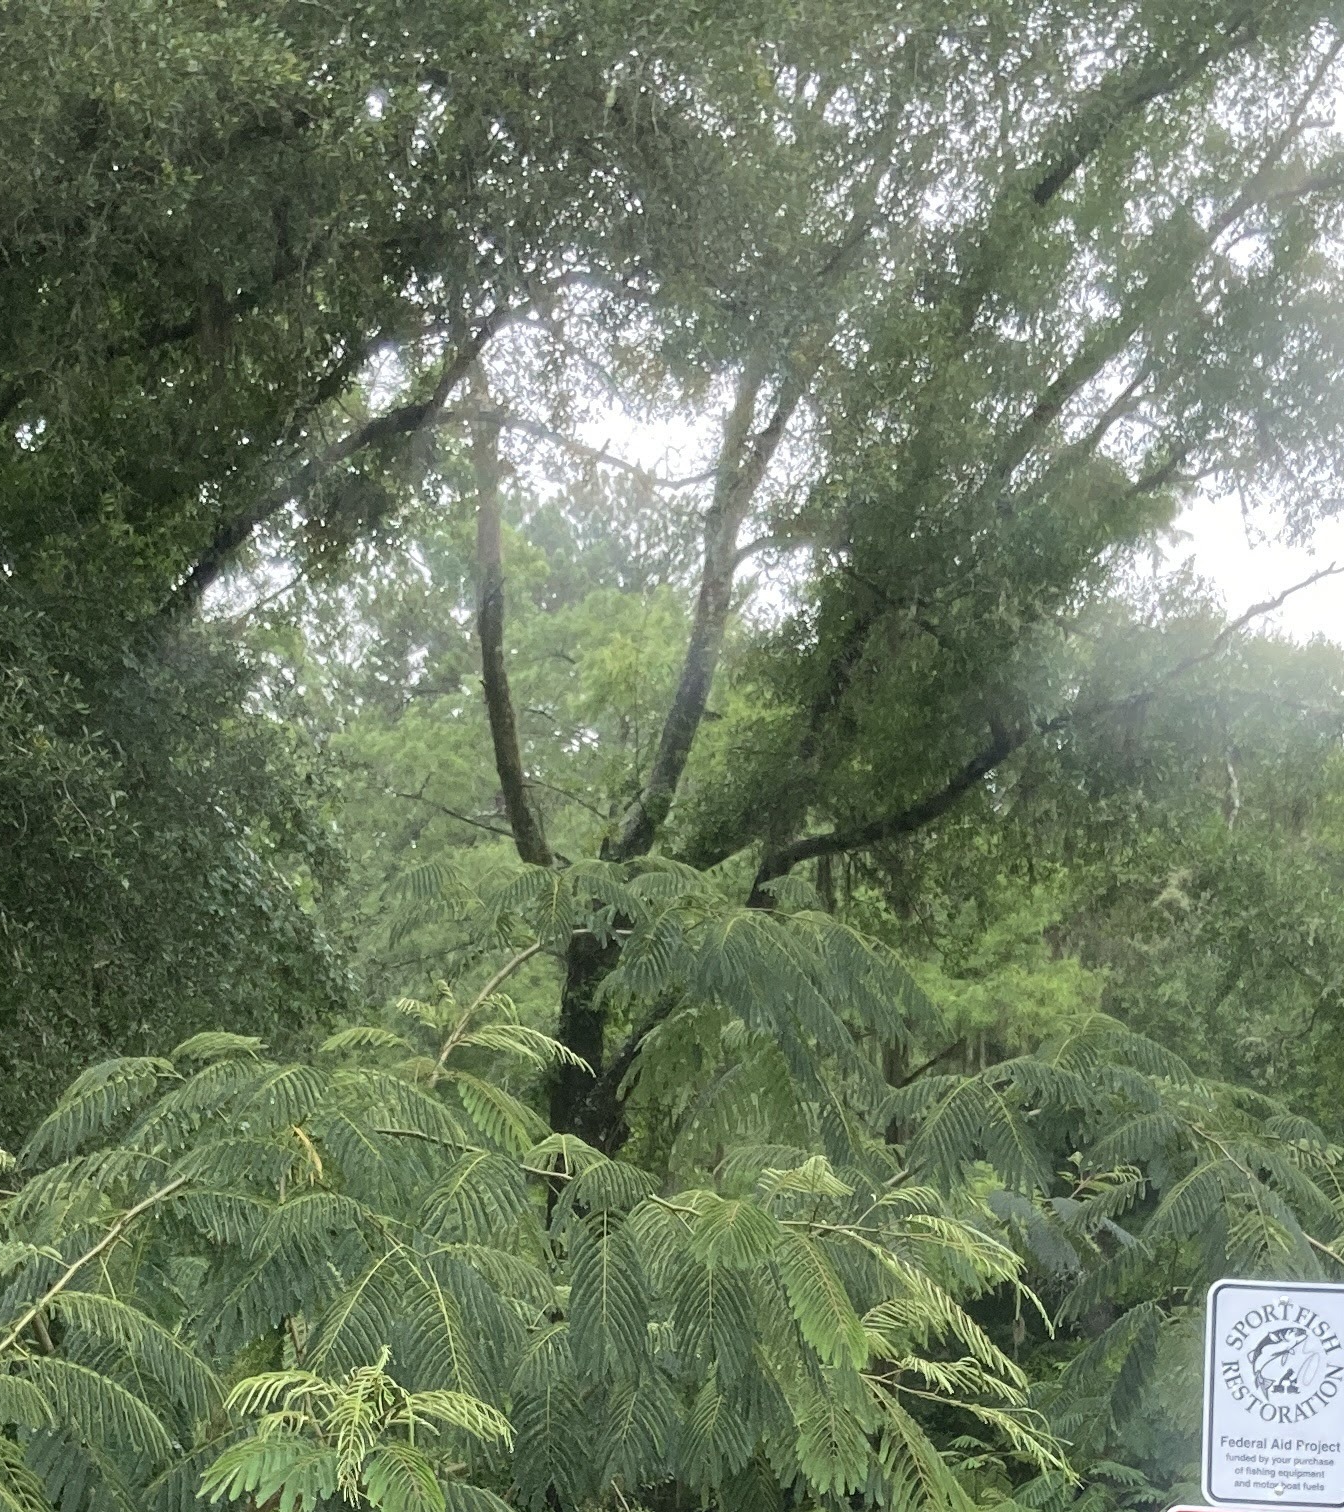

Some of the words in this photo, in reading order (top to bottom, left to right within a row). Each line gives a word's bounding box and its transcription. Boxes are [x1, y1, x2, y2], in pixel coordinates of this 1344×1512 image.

[1221, 1360, 1344, 1424] RESTORATION
[1220, 1435, 1267, 1449] Federal
[1270, 1438, 1292, 1451] Aid
[1296, 1439, 1341, 1454] Project
[1226, 1453, 1257, 1463] funded
[1259, 1455, 1269, 1465] by
[1272, 1456, 1292, 1466] your
[1294, 1457, 1334, 1466] purchase
[1234, 1467, 1244, 1475] of
[1246, 1467, 1276, 1478] fishing
[1278, 1469, 1325, 1479] equipment
[1234, 1480, 1251, 1488] and
[1253, 1481, 1279, 1489] motor
[1303, 1482, 1325, 1491] fuels
